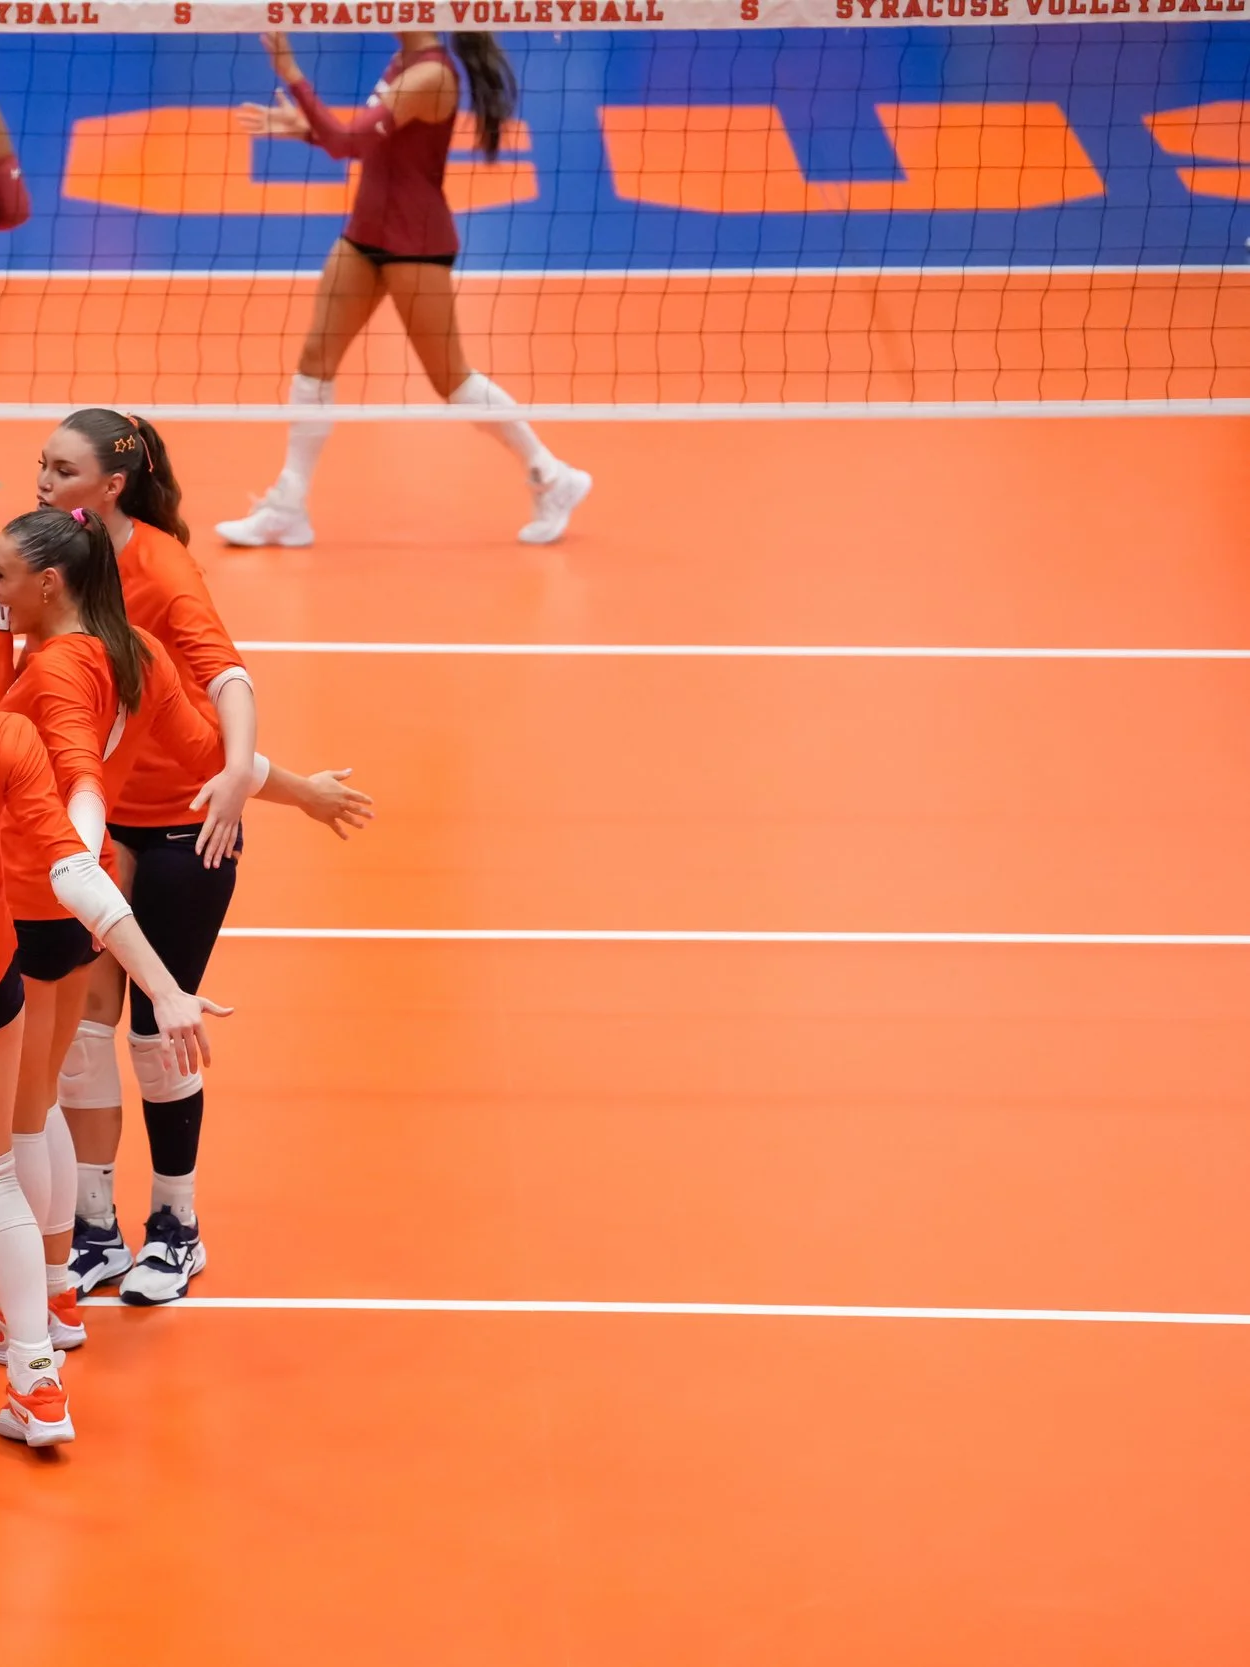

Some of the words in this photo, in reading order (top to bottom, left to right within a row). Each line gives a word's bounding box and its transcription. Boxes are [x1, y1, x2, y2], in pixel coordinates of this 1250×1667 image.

[174, 2, 191, 25] S
[267, 2, 435, 24] SYRACUSE
[450, 0, 664, 24] VOLLEYBALL
[740, 0, 758, 21] S
[836, 0, 1009, 19] SYRACUSE
